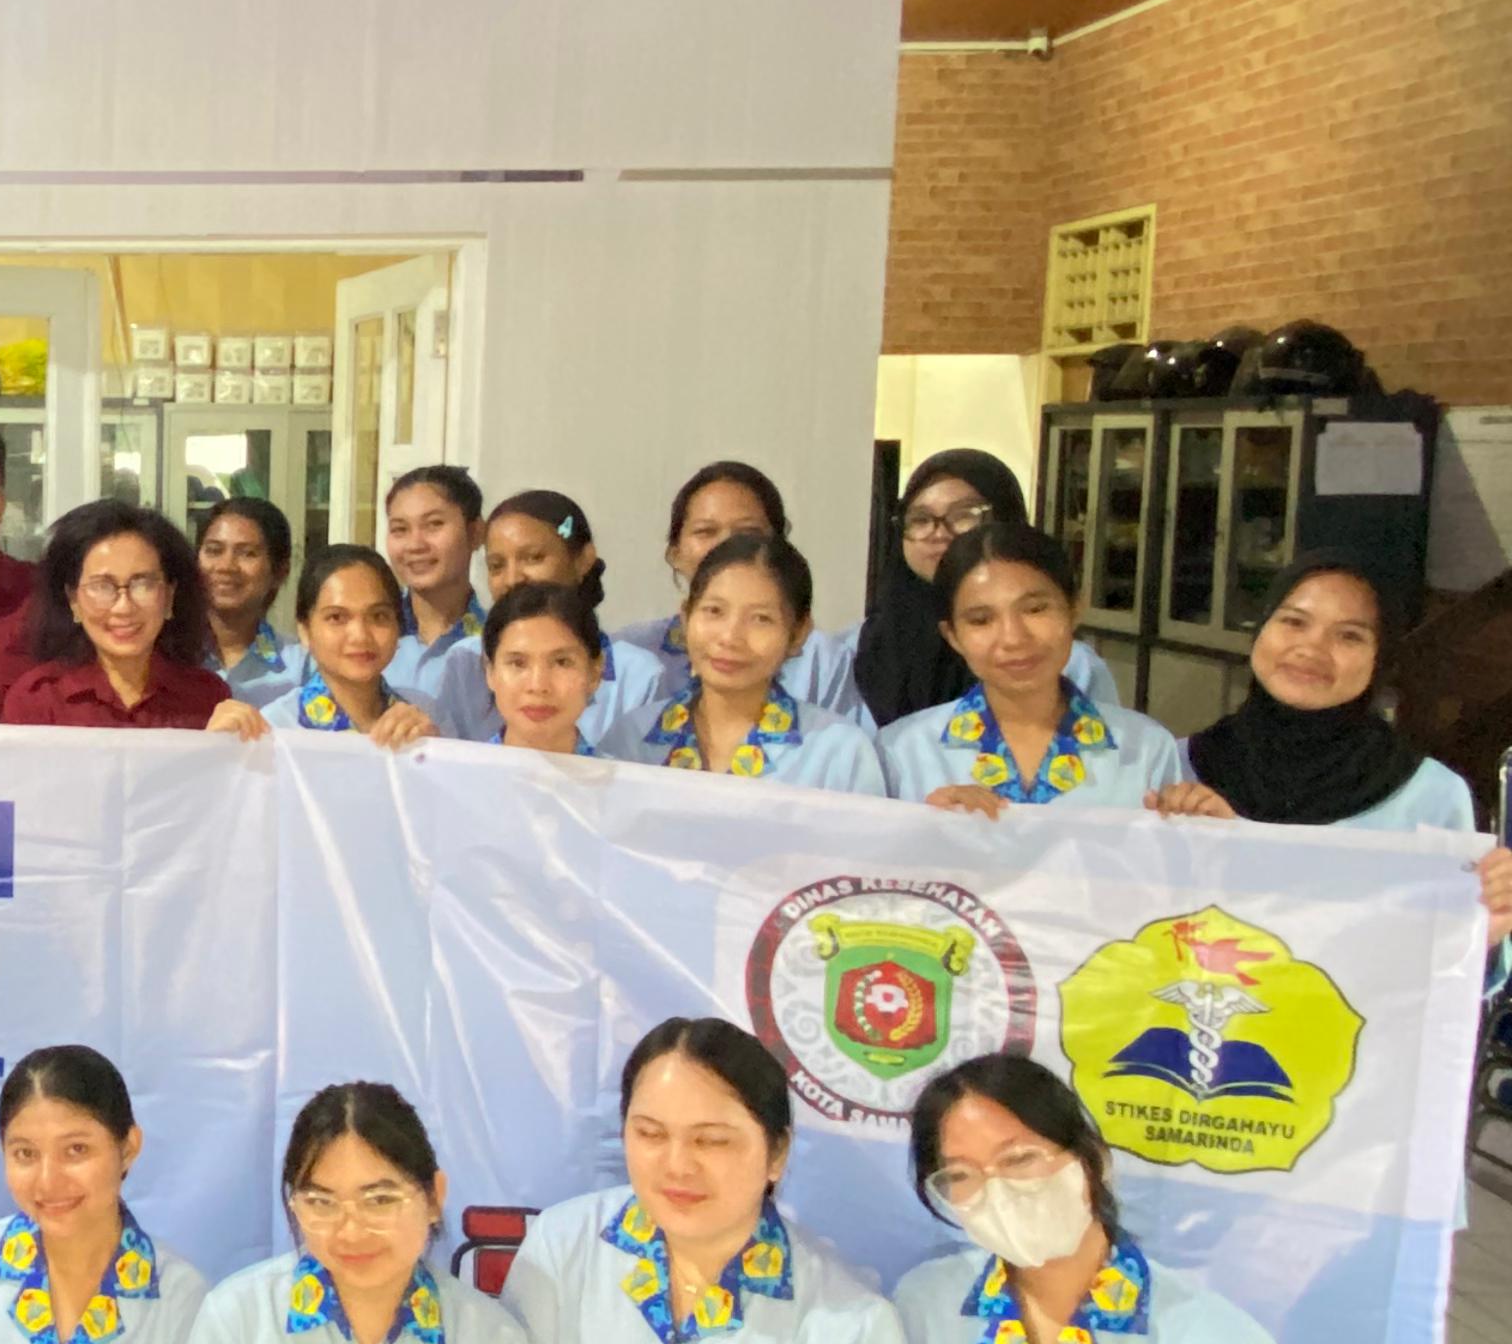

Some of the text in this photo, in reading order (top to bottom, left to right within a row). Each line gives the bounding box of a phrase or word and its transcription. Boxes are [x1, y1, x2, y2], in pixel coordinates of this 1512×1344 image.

[782, 877, 1003, 938] DINAS KESEHATAN
[790, 1070, 844, 1118] KOTA
[1105, 1100, 1295, 1140] STIKES DIRGAHAYU
[1144, 1125, 1255, 1153] SAMARINDA
